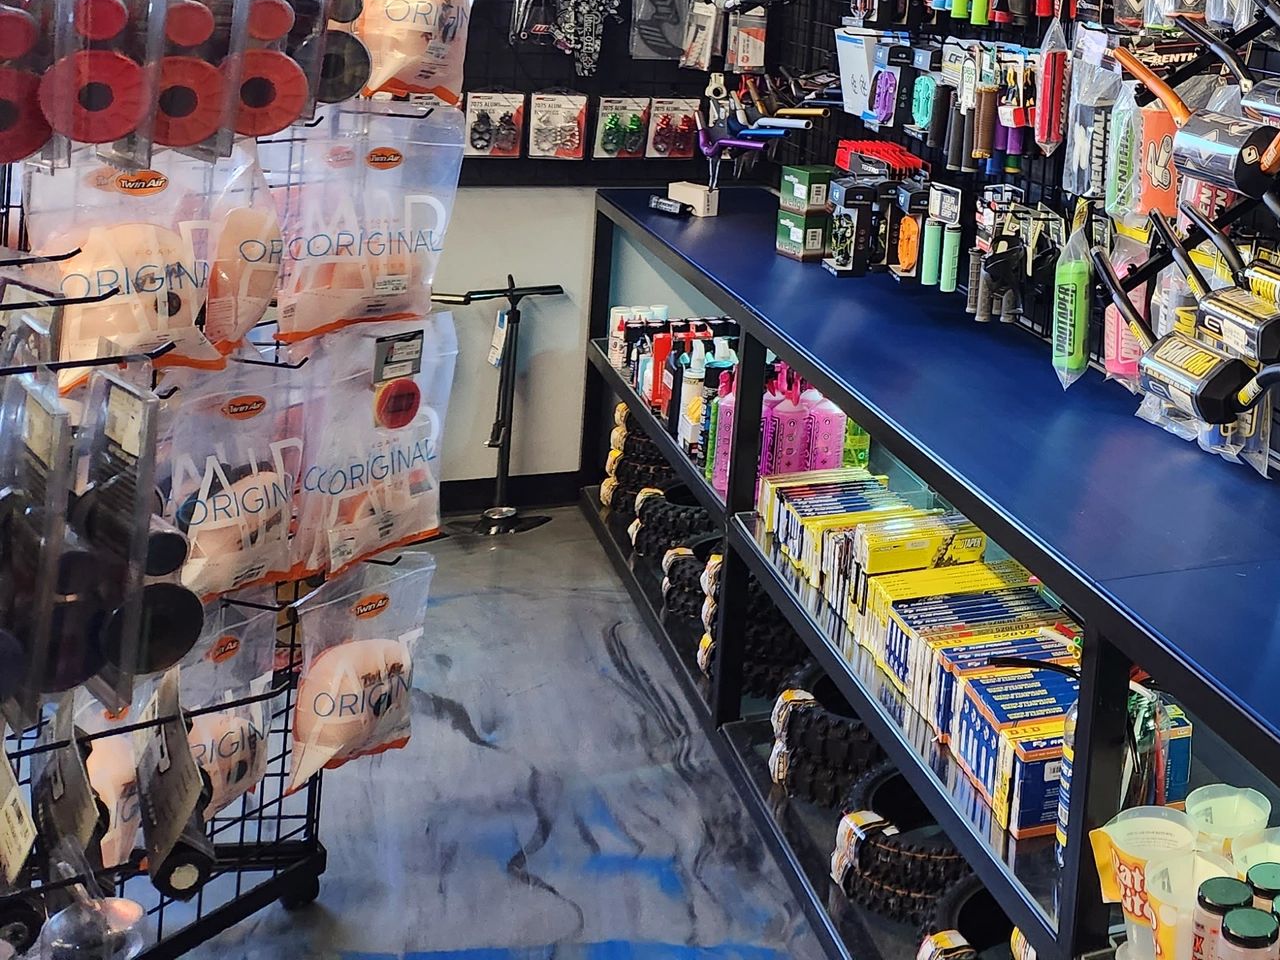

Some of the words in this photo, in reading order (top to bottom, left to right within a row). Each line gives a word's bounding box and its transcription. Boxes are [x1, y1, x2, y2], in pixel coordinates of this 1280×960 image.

[369, 154, 386, 163] Twin
[386, 153, 402, 163] Air
[119, 179, 145, 189] Twin
[146, 177, 165, 189] Air
[306, 229, 444, 257] ORIGINAL
[355, 604, 376, 616] Twin
